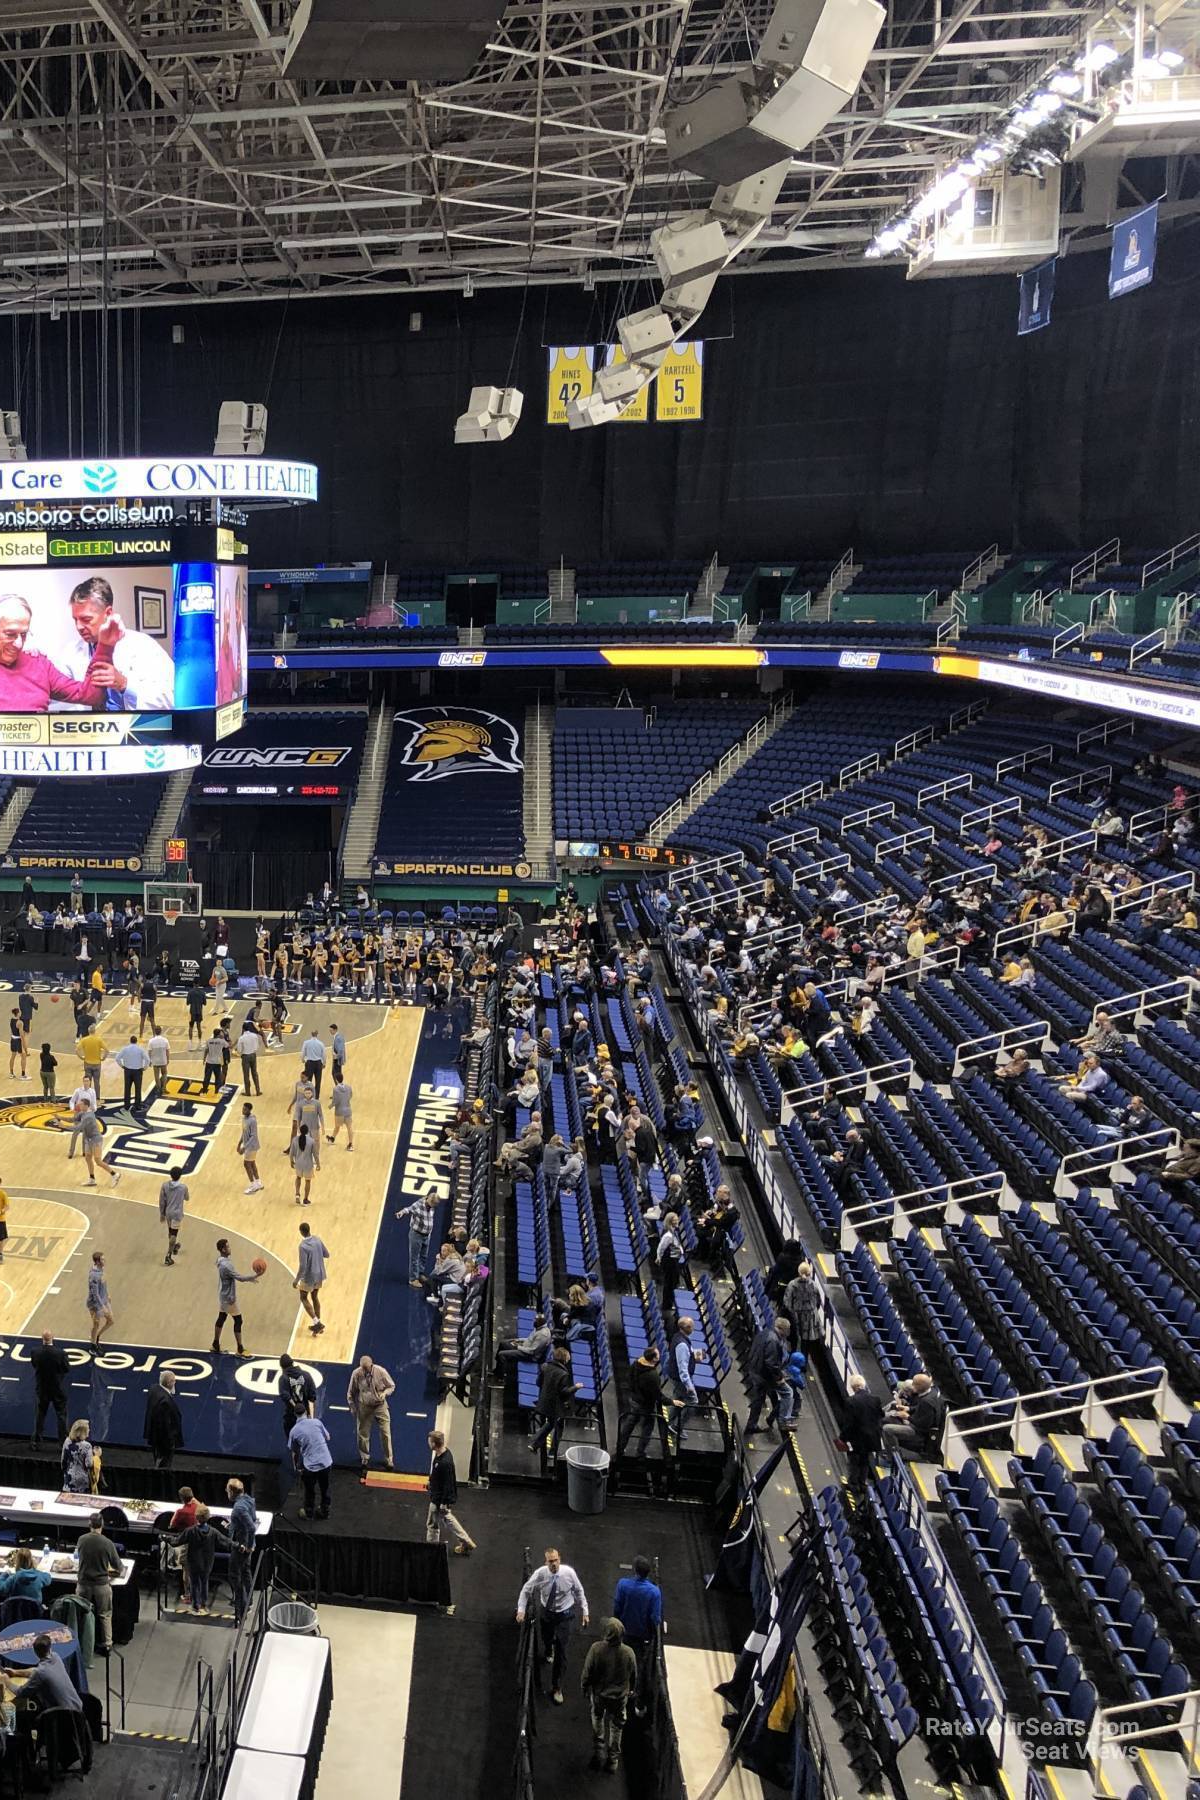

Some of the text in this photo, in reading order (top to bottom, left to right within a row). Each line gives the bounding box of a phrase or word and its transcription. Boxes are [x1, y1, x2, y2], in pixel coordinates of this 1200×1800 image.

[561, 369, 581, 379] HINES
[664, 366, 696, 375] HARTZELL
[559, 382, 582, 407] 42
[674, 379, 685, 403] 5
[12, 469, 63, 489] Care
[146, 463, 312, 494] CONE HEALTH
[79, 504, 173, 523] Coliseum
[49, 538, 171, 557] GREEN LINCOLN
[279, 571, 316, 579] WYNDHAM
[438, 651, 488, 667] UNCG
[839, 651, 881, 669] UNCG
[52, 721, 120, 733] SEGRA
[3, 750, 107, 771] HEALTH
[206, 749, 348, 766] UNCG
[168, 840, 185, 848] 17:40
[169, 847, 183, 860] 30
[19, 856, 126, 869] SPARTAN CLUB
[394, 863, 513, 876] SPARTAN CLUB
[180, 959, 200, 968] TFA
[108, 1076, 232, 1176] UNCG
[401, 1082, 461, 1199] SPARTANS
